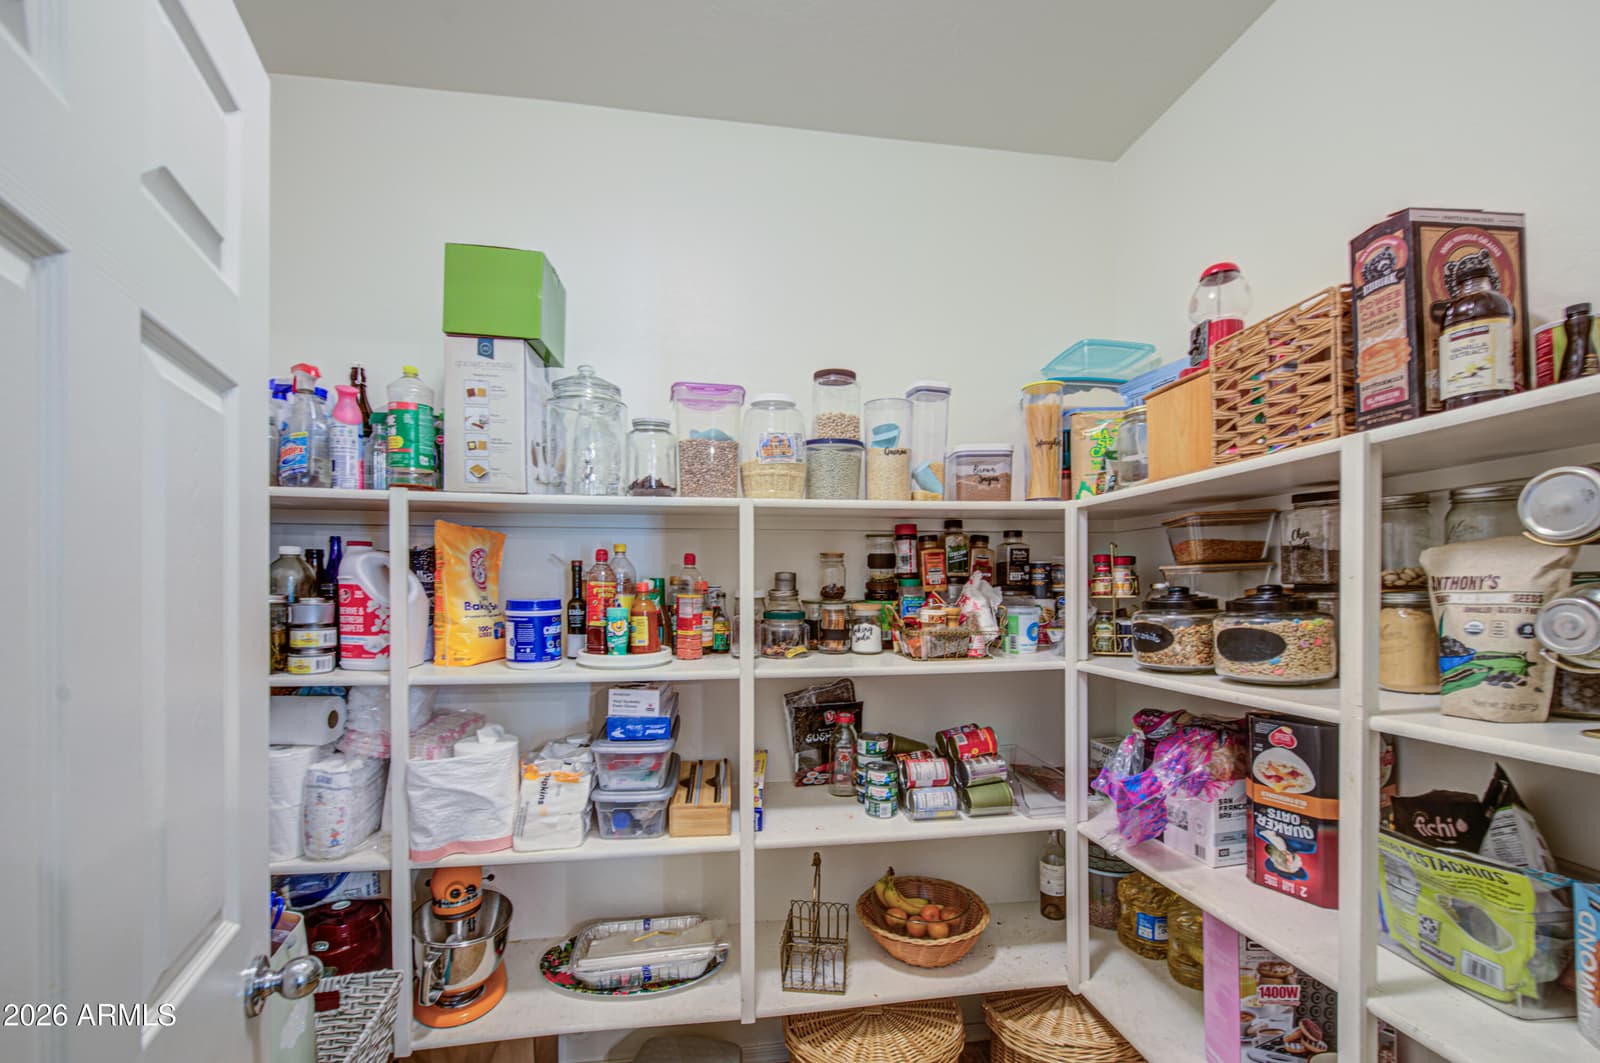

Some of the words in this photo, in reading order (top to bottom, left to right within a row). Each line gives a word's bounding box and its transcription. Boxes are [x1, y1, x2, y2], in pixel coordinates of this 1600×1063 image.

[1218, 798, 1234, 806] SAN
[1266, 808, 1301, 825] OATS
[1254, 811, 1315, 840] QUAKER
[1400, 845, 1510, 886] PISTACHIOS
[1299, 886, 1308, 898] 2
[1258, 986, 1299, 999] 1400W
